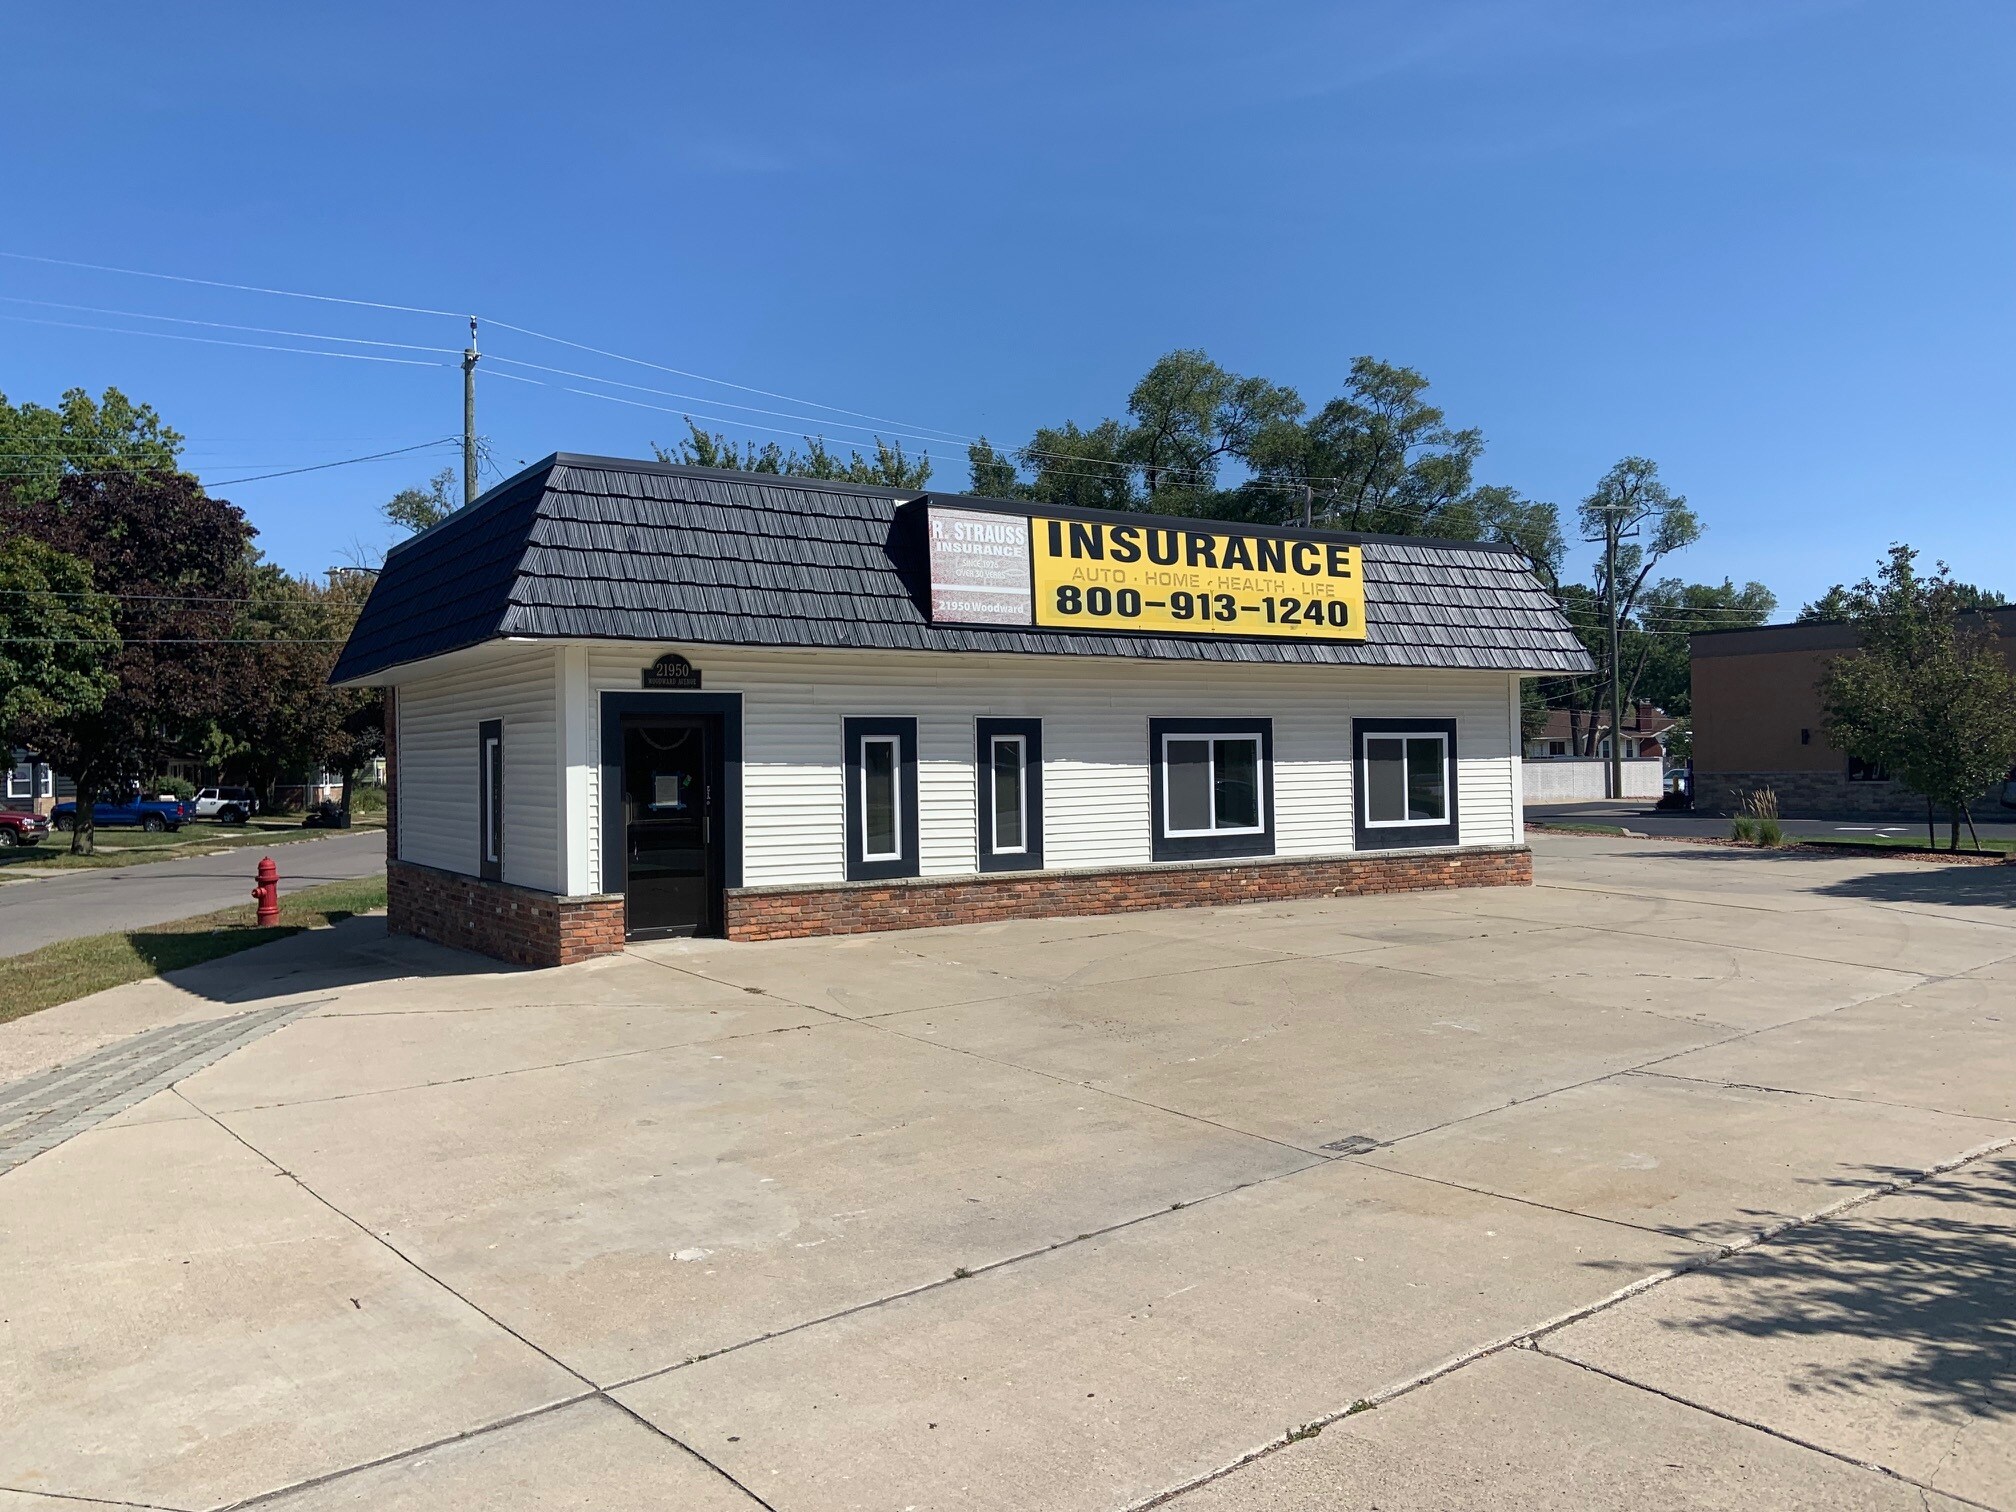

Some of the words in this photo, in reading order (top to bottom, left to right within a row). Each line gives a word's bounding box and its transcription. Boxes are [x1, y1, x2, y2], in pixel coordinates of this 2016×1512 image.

[932, 520, 949, 539] R.
[954, 521, 1025, 545] STRAUSS
[936, 541, 1023, 557] INSURANCE
[1047, 521, 1351, 578] INSURANCE
[1072, 567, 1126, 583] AUTO
[1145, 572, 1200, 588] HOME
[1218, 576, 1285, 593] HEALTH
[1302, 582, 1335, 598] LIFE
[939, 601, 970, 611] 21950
[971, 602, 1024, 613] Woodward
[1056, 585, 1349, 627] 800-913-1240
[656, 663, 689, 677] 21950
